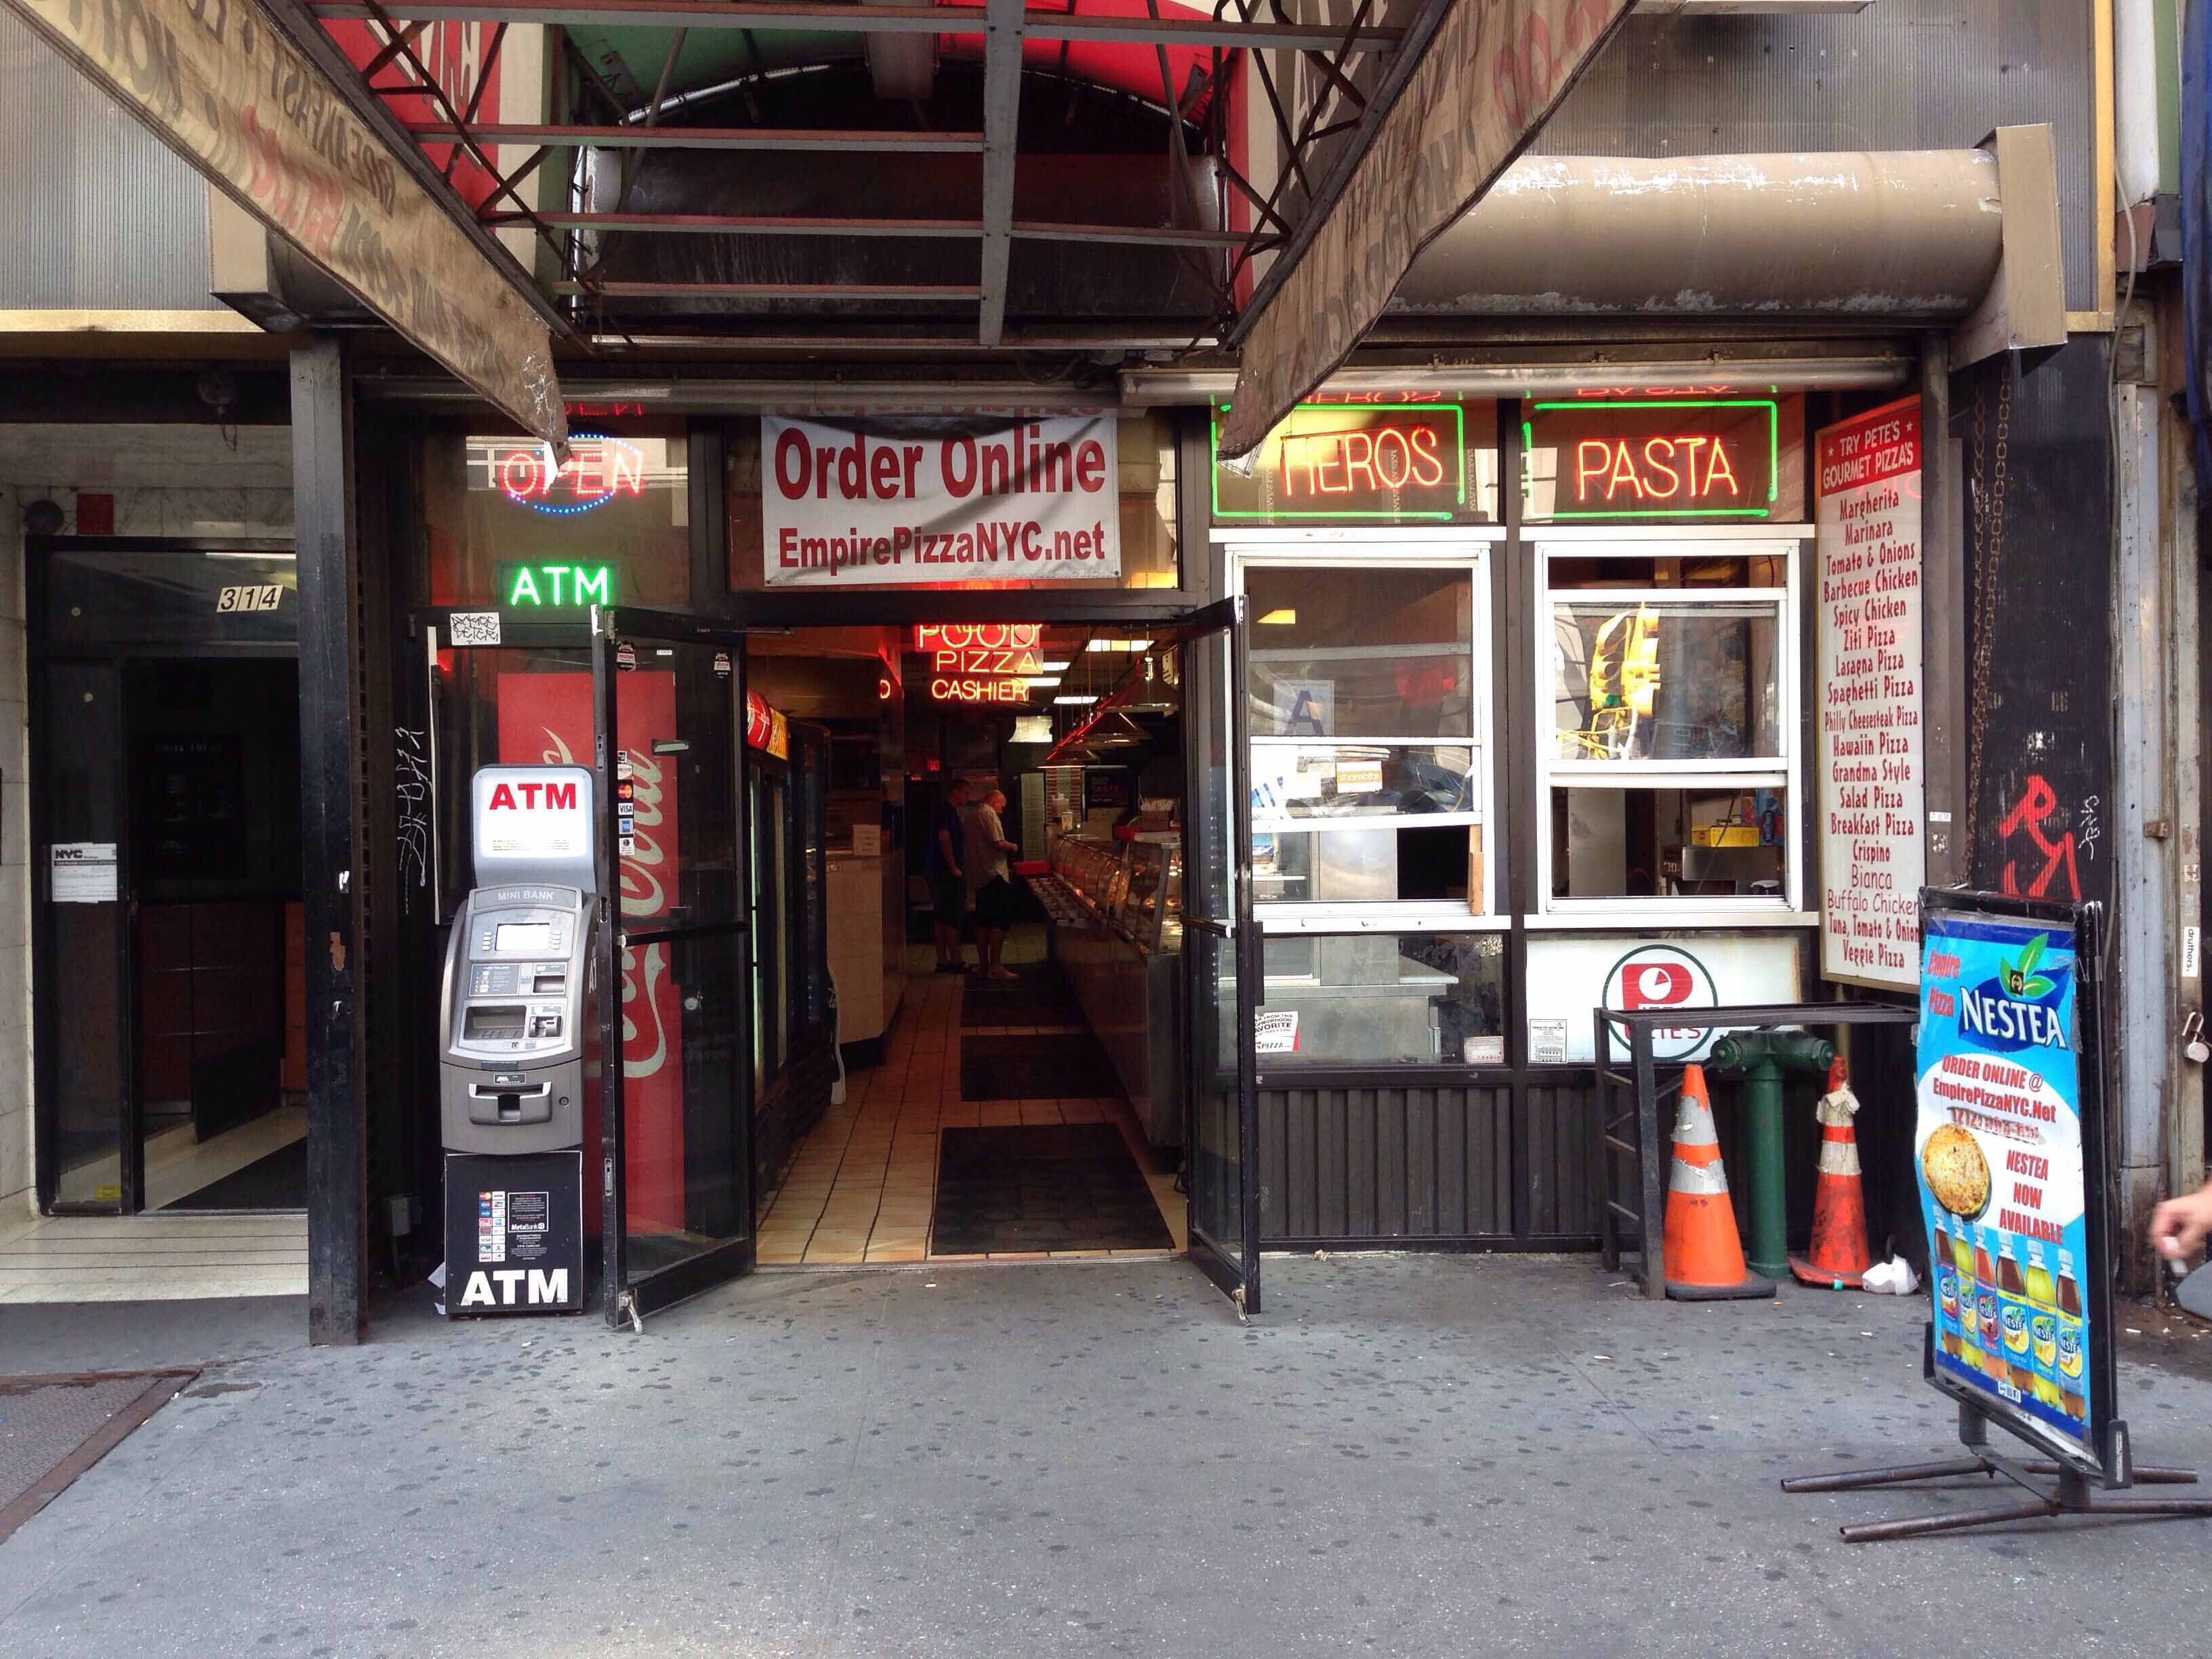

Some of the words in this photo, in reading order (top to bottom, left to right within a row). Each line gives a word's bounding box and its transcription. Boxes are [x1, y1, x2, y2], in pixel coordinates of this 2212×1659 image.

[1839, 434, 1860, 457] TRY
[1864, 420, 1900, 451] PETE'S
[775, 428, 923, 500] Order
[941, 424, 1105, 498] Online
[1283, 428, 1443, 497] HEROS
[1578, 436, 1737, 501] PASTA
[1823, 455, 1870, 489] GOURMET
[1875, 442, 1914, 474] PIZZA'S
[1839, 488, 1900, 522] Margherita
[1844, 520, 1893, 546] Marinara
[779, 520, 1105, 576] EmpirePizzaNYC.net
[1826, 554, 1862, 577] Tomato
[1867, 547, 1875, 568] &
[1880, 542, 1915, 565] Onions
[221, 587, 276, 610] 314
[511, 567, 608, 606] ATM
[1824, 578, 1870, 603] Barbecue
[1875, 567, 1918, 593] Chicken
[1833, 606, 1859, 628] Spicy
[1864, 599, 1906, 621] Chicken
[1843, 628, 1862, 652] Ziti
[1868, 625, 1895, 647] Pizza
[937, 651, 1039, 673] PIZZA
[1836, 655, 1873, 678] Lasagna
[1878, 649, 1904, 670] Pizza
[932, 680, 1028, 701] CASHIER
[1828, 680, 1878, 705] Spaghetti
[1884, 676, 1913, 699] Pizza
[1824, 710, 1846, 735] Philly
[1849, 708, 1894, 731] Cheesesteak
[1897, 705, 1918, 726] Pizza
[1832, 733, 1875, 757] Hawaiin
[1879, 731, 1908, 755] Pizza
[1832, 760, 1877, 783] Grandma
[1883, 757, 1910, 785] Style
[489, 783, 576, 810] ATM
[1840, 786, 1868, 809] Salad
[1874, 786, 1902, 809] Pizza
[1830, 813, 1880, 836] Breakfast
[1886, 812, 1913, 835] Pizza
[56, 849, 83, 859] NYC
[1853, 839, 1890, 865] Crispino
[1851, 864, 1892, 890] Bianca
[498, 891, 520, 901] MINI
[524, 890, 553, 900] BANK
[1827, 889, 1868, 914] Buffalo
[1829, 912, 1849, 938] Tuna,
[1853, 914, 1883, 939] Tomato
[1843, 939, 1874, 967] Veggie
[1878, 942, 1904, 968] Pizza
[1929, 987, 1954, 1017] Pizza
[1959, 986, 2069, 1052] NESTEA
[1942, 1054, 1981, 1080] ORDER
[1982, 1063, 2027, 1089] ONLINE
[2028, 1073, 2044, 1092] @
[1932, 1077, 2057, 1123] EmpirePizzaNYC.Net
[2006, 1149, 2049, 1181] NESTEA
[2013, 1182, 2043, 1210] NOW
[1999, 1208, 2064, 1245] AVAILABLE
[460, 1268, 569, 1306] ATM
